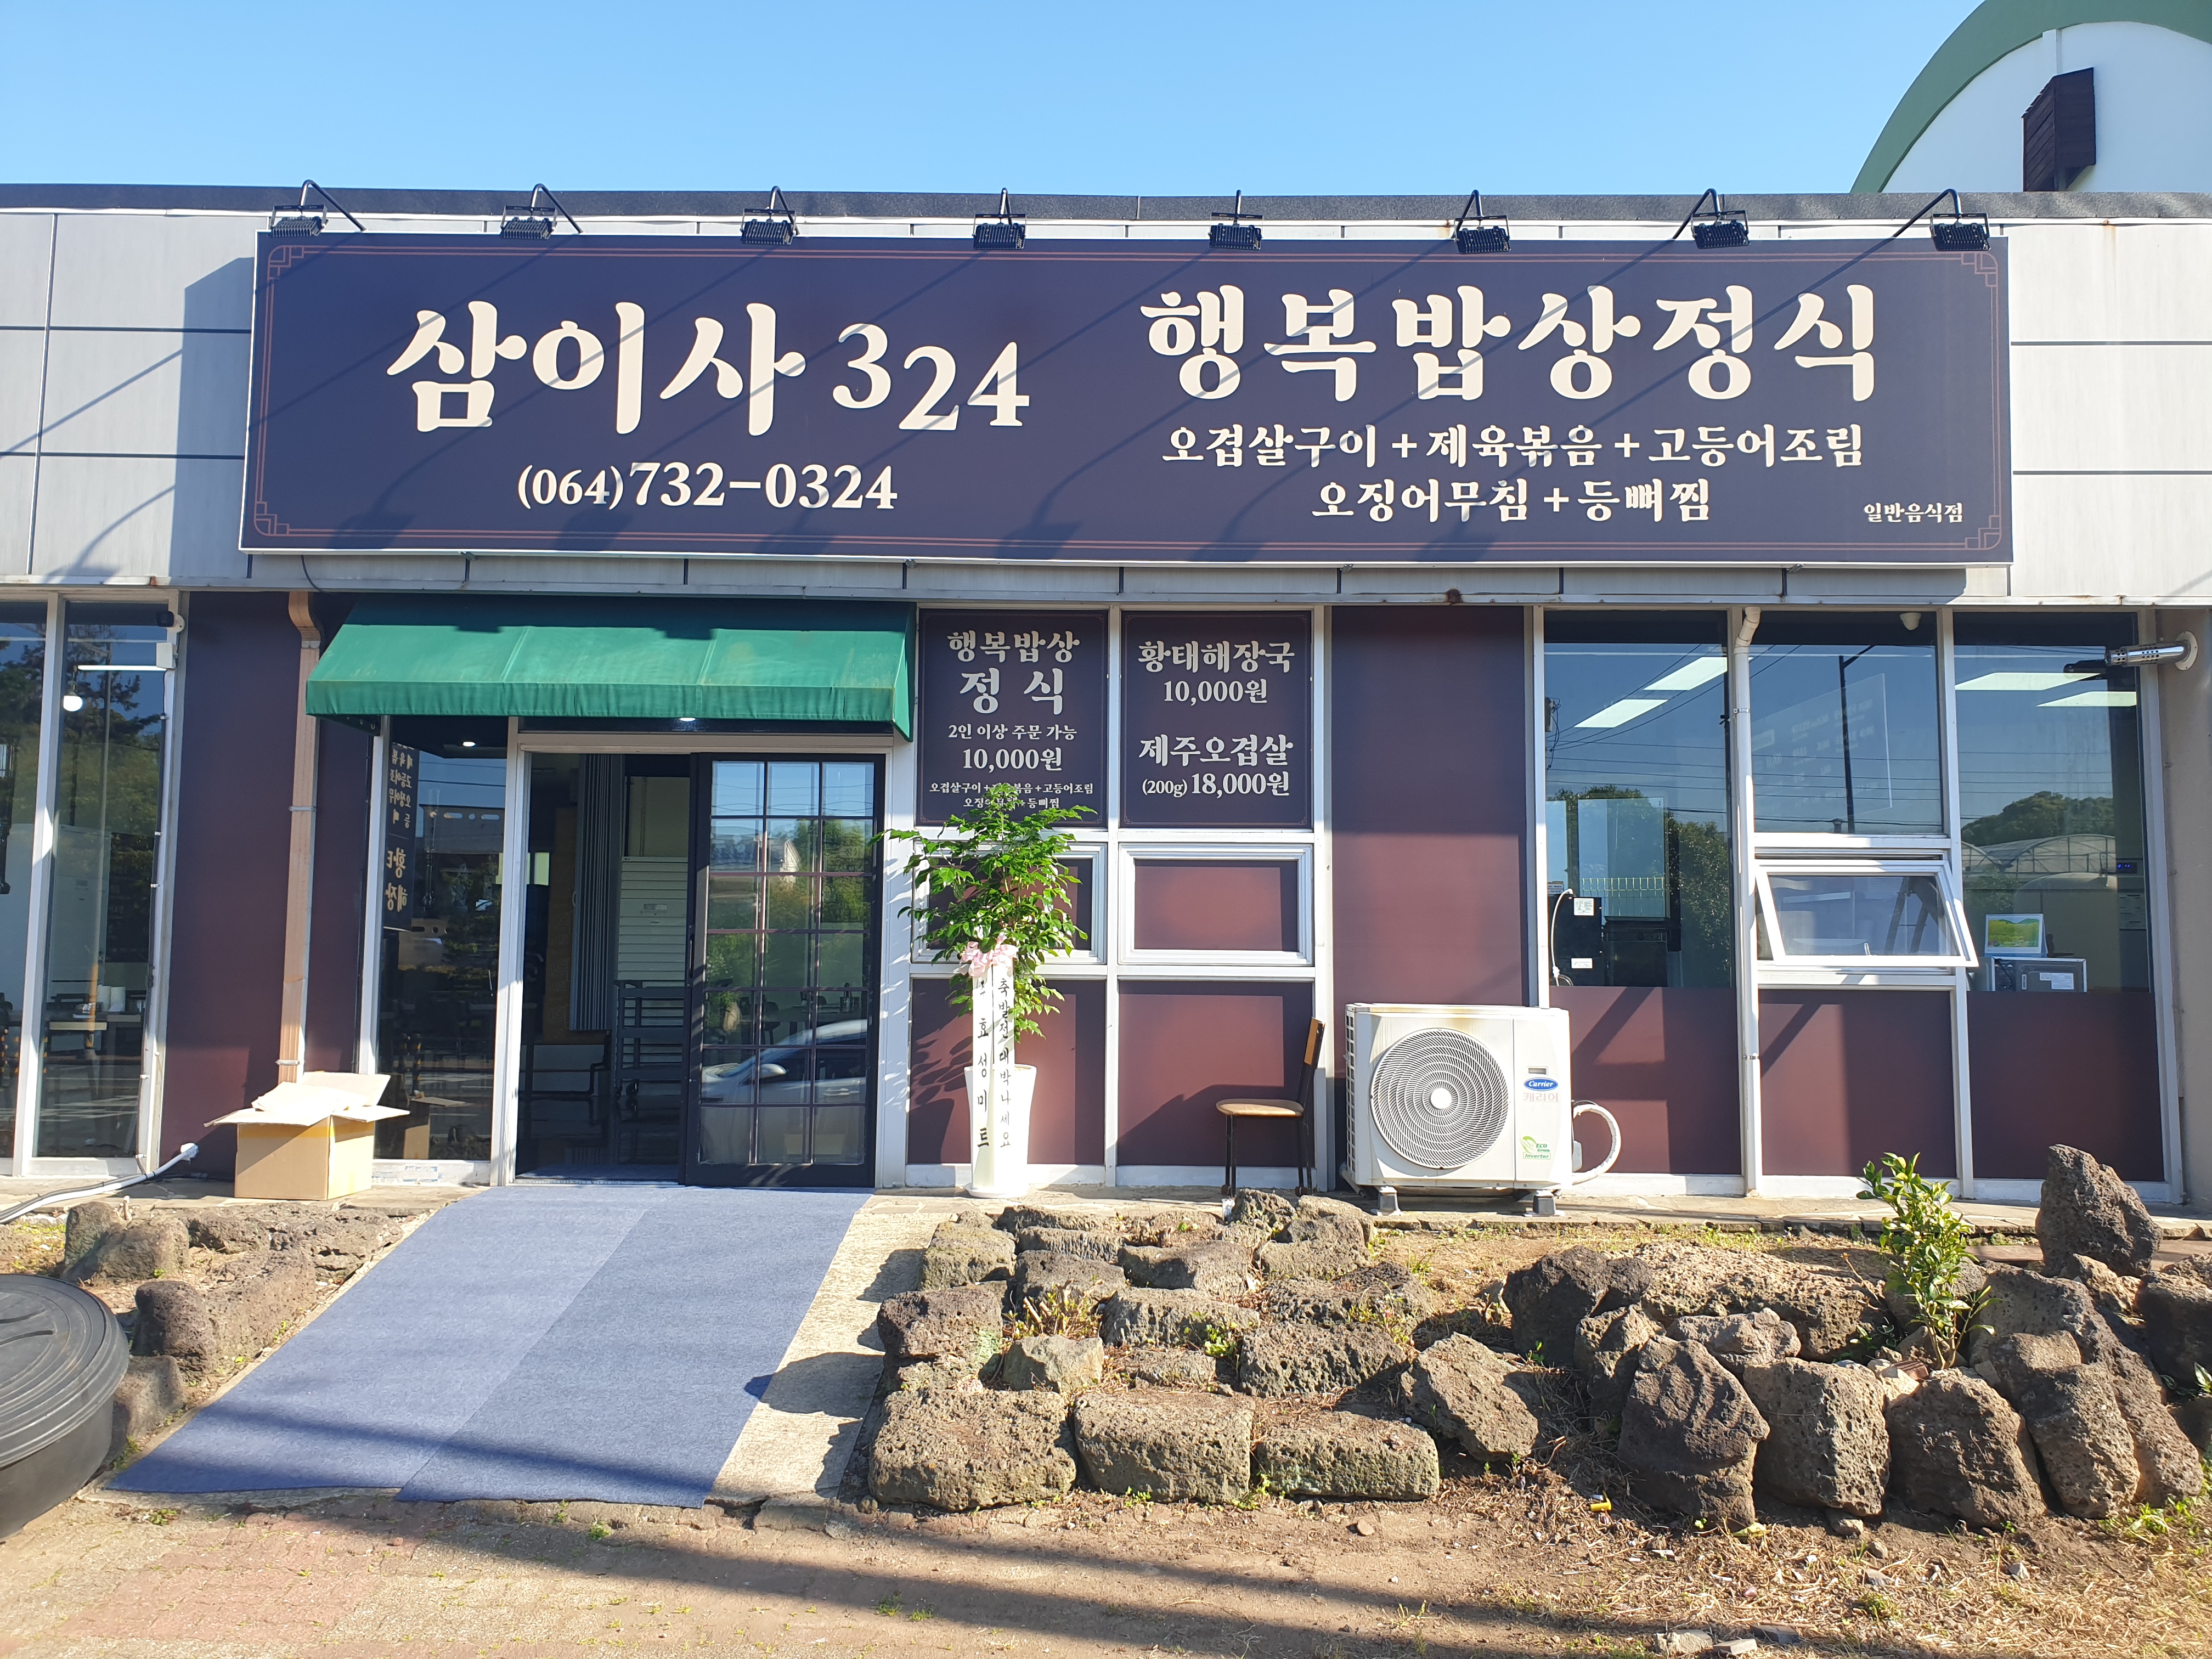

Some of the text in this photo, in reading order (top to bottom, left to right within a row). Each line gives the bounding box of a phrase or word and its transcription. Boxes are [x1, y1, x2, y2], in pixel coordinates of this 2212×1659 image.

[1139, 284, 1875, 402] 행복밥상정식
[386, 300, 1030, 437] 삼이사 324
[1162, 423, 1376, 469] 오겹살구이
[1426, 424, 1603, 469] 제육볶음
[1648, 423, 1863, 468] 고등어조림
[518, 461, 898, 511] (064)732-0324
[1311, 477, 1528, 523] 오징어무침
[1577, 478, 1709, 523] 등뼈찜
[1863, 501, 1963, 523] 일반음식점
[947, 630, 1080, 663] 행복밥상
[1138, 640, 1295, 673] 황태해장국
[1164, 678, 1267, 706] 10,000원
[948, 723, 1077, 741] 2인 이상 주문 가능
[963, 747, 1063, 773] 10,000원
[1138, 734, 1294, 767] 제주오겹살
[929, 782, 981, 794] 오겹살구이
[1042, 782, 1093, 794] 고등어조림
[1142, 770, 1290, 799] (200g) 18,000원
[1523, 1092, 1559, 1102] 캐리어
